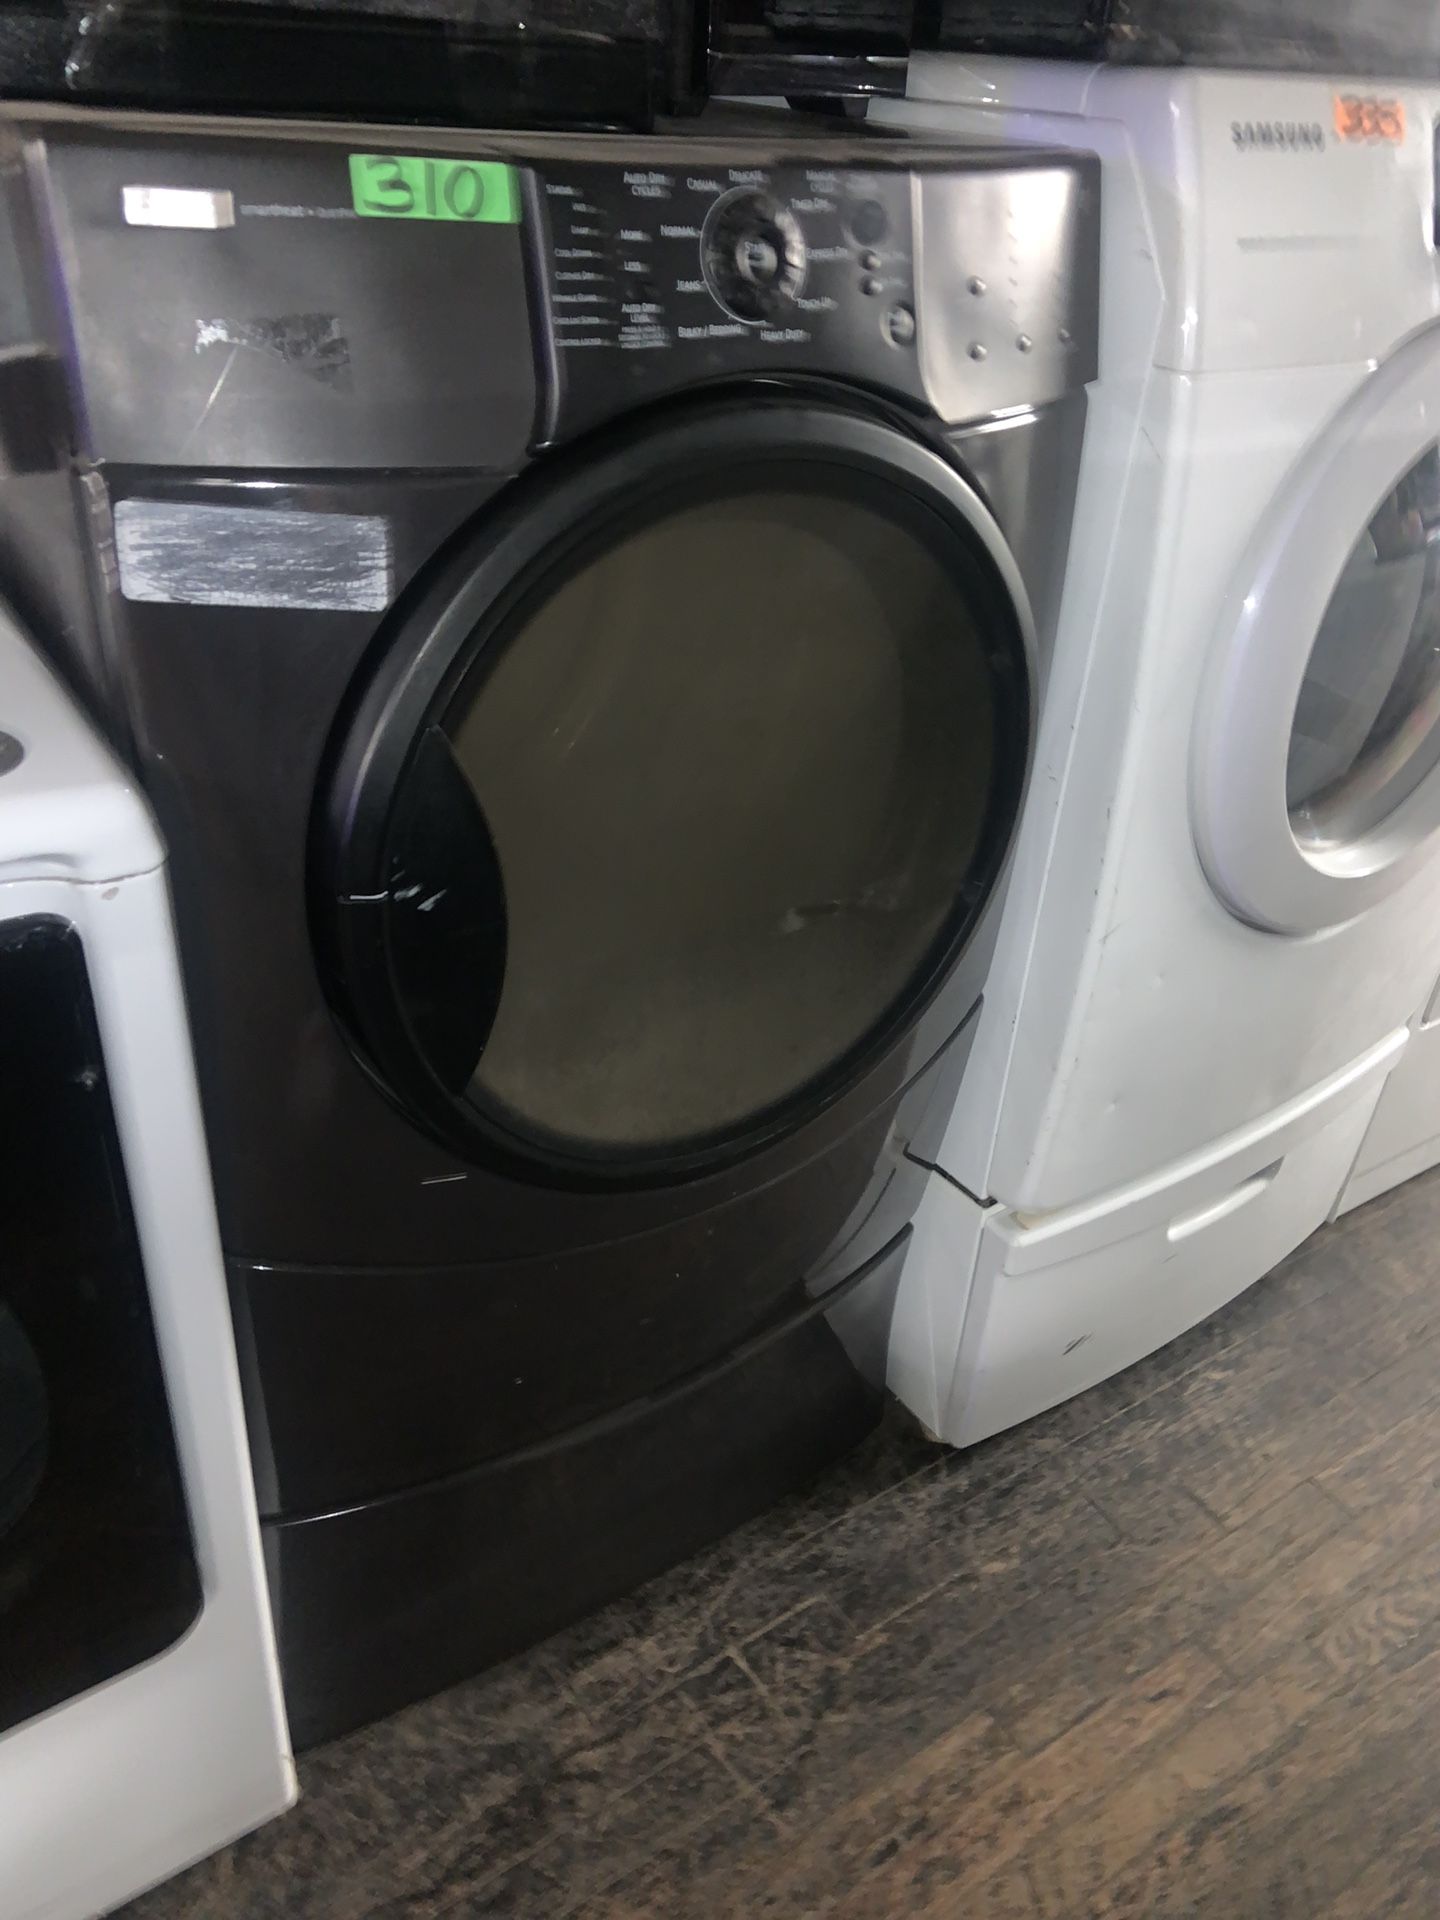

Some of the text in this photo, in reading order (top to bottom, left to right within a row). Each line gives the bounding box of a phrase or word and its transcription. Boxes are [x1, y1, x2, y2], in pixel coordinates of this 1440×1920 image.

[1231, 120, 1326, 152] SAMSUNG
[362, 156, 484, 218] 310
[660, 224, 697, 239] NORMAL
[676, 279, 704, 293] JEANS
